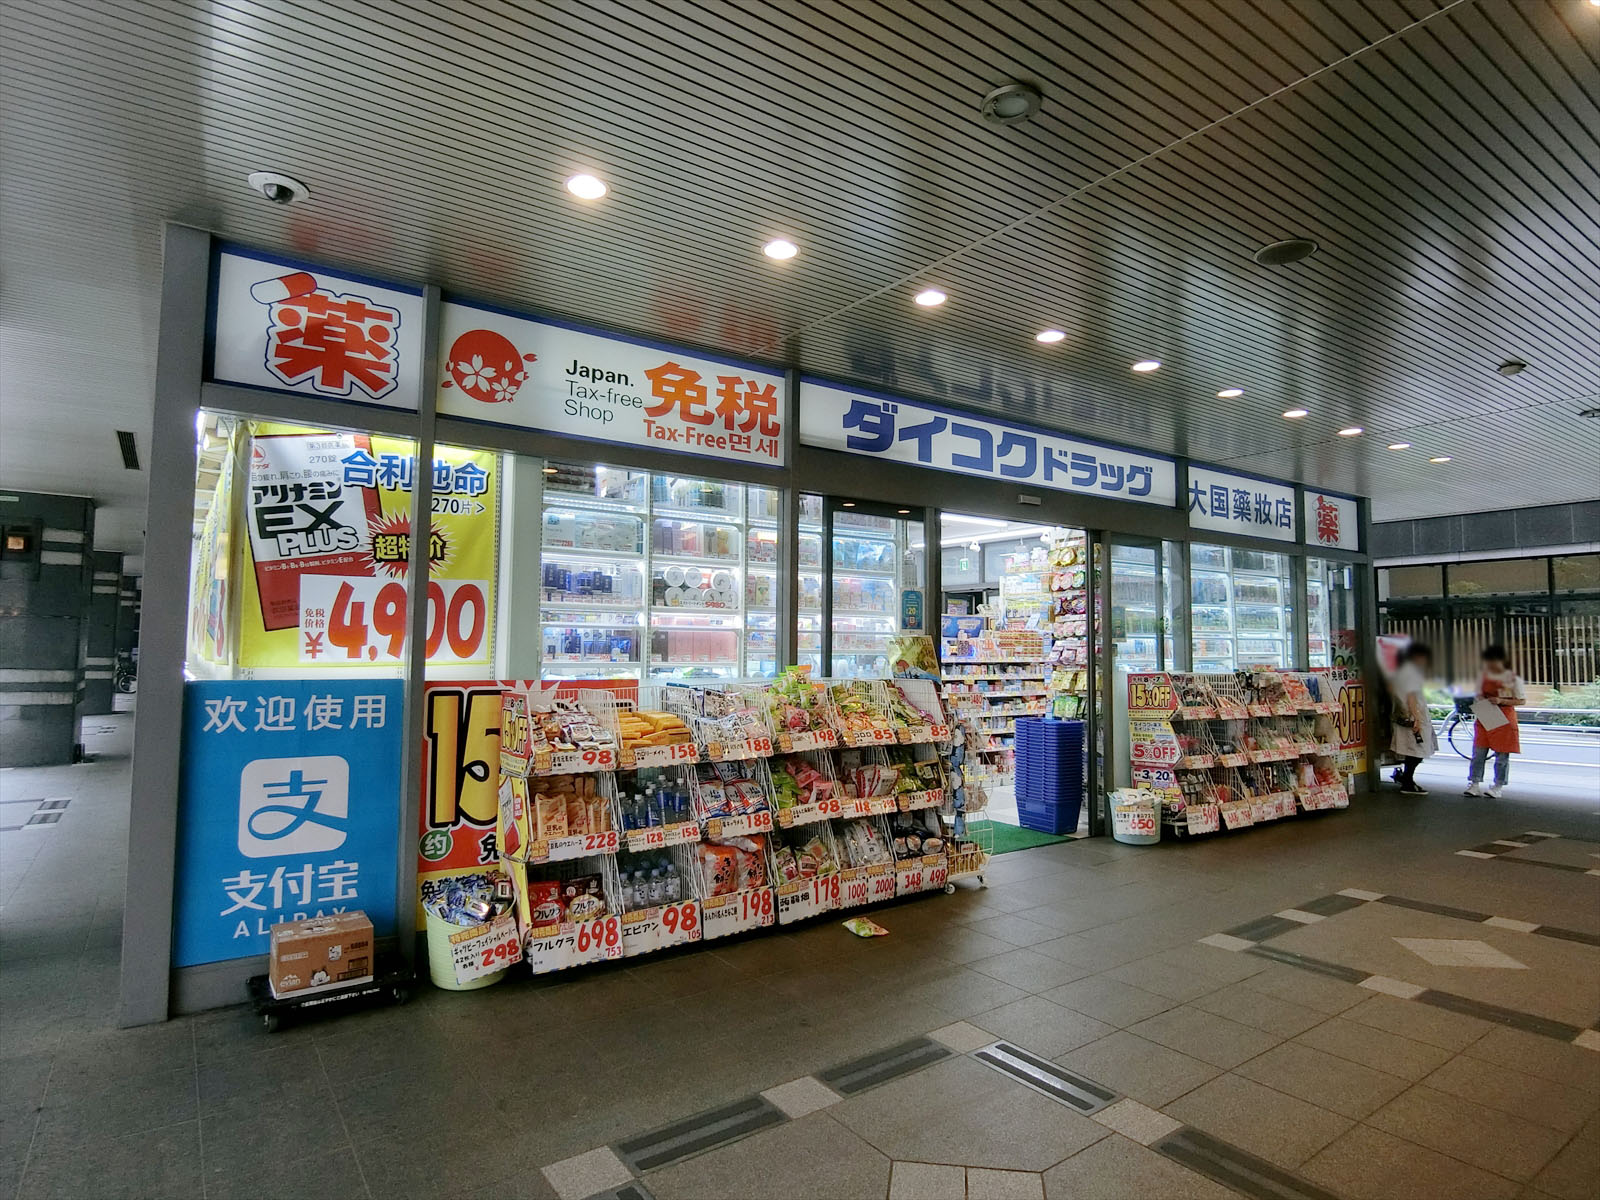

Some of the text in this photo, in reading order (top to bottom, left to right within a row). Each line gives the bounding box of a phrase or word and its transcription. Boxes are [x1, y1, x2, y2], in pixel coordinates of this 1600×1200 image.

[272, 289, 395, 394] 薬
[565, 360, 634, 387] Japan.
[565, 380, 643, 409] Tax-free
[644, 361, 781, 438] 免税
[564, 399, 614, 424] Shop
[643, 419, 779, 458] Tax-Free 면세
[842, 399, 1153, 497] ダイコクドラッグ
[252, 481, 342, 505] アリナミン
[256, 500, 345, 540] EX
[1317, 502, 1339, 544] 薬
[277, 525, 360, 557] PLUS
[305, 608, 325, 618] 免税
[304, 618, 325, 629] 价格
[1130, 683, 1170, 708] 15%OFF
[202, 694, 387, 734] 欢迎使用
[812, 729, 835, 744] 198
[873, 729, 893, 740] 85
[930, 725, 949, 737] 85
[669, 743, 697, 760] 158
[746, 738, 771, 752] 188
[1133, 743, 1176, 760] 5%OFF
[582, 749, 613, 765] 98
[818, 799, 840, 814] 98
[747, 812, 771, 828] 188
[585, 831, 617, 851] 228
[646, 831, 664, 844] 128
[682, 826, 699, 838] 158
[904, 871, 921, 889] 348
[929, 868, 946, 885] 498
[219, 860, 359, 917] 支付宝
[813, 873, 840, 905] 178
[847, 882, 866, 900] 1000
[874, 877, 894, 895] 2000
[742, 889, 772, 921] 198
[662, 903, 698, 935] 98
[761, 914, 774, 925] 213
[577, 917, 619, 953] 698
[623, 922, 659, 937] エビアン
[688, 929, 701, 940] 105
[480, 938, 520, 967] 298
[533, 936, 575, 952] フルグラ
[605, 946, 622, 957] 753
